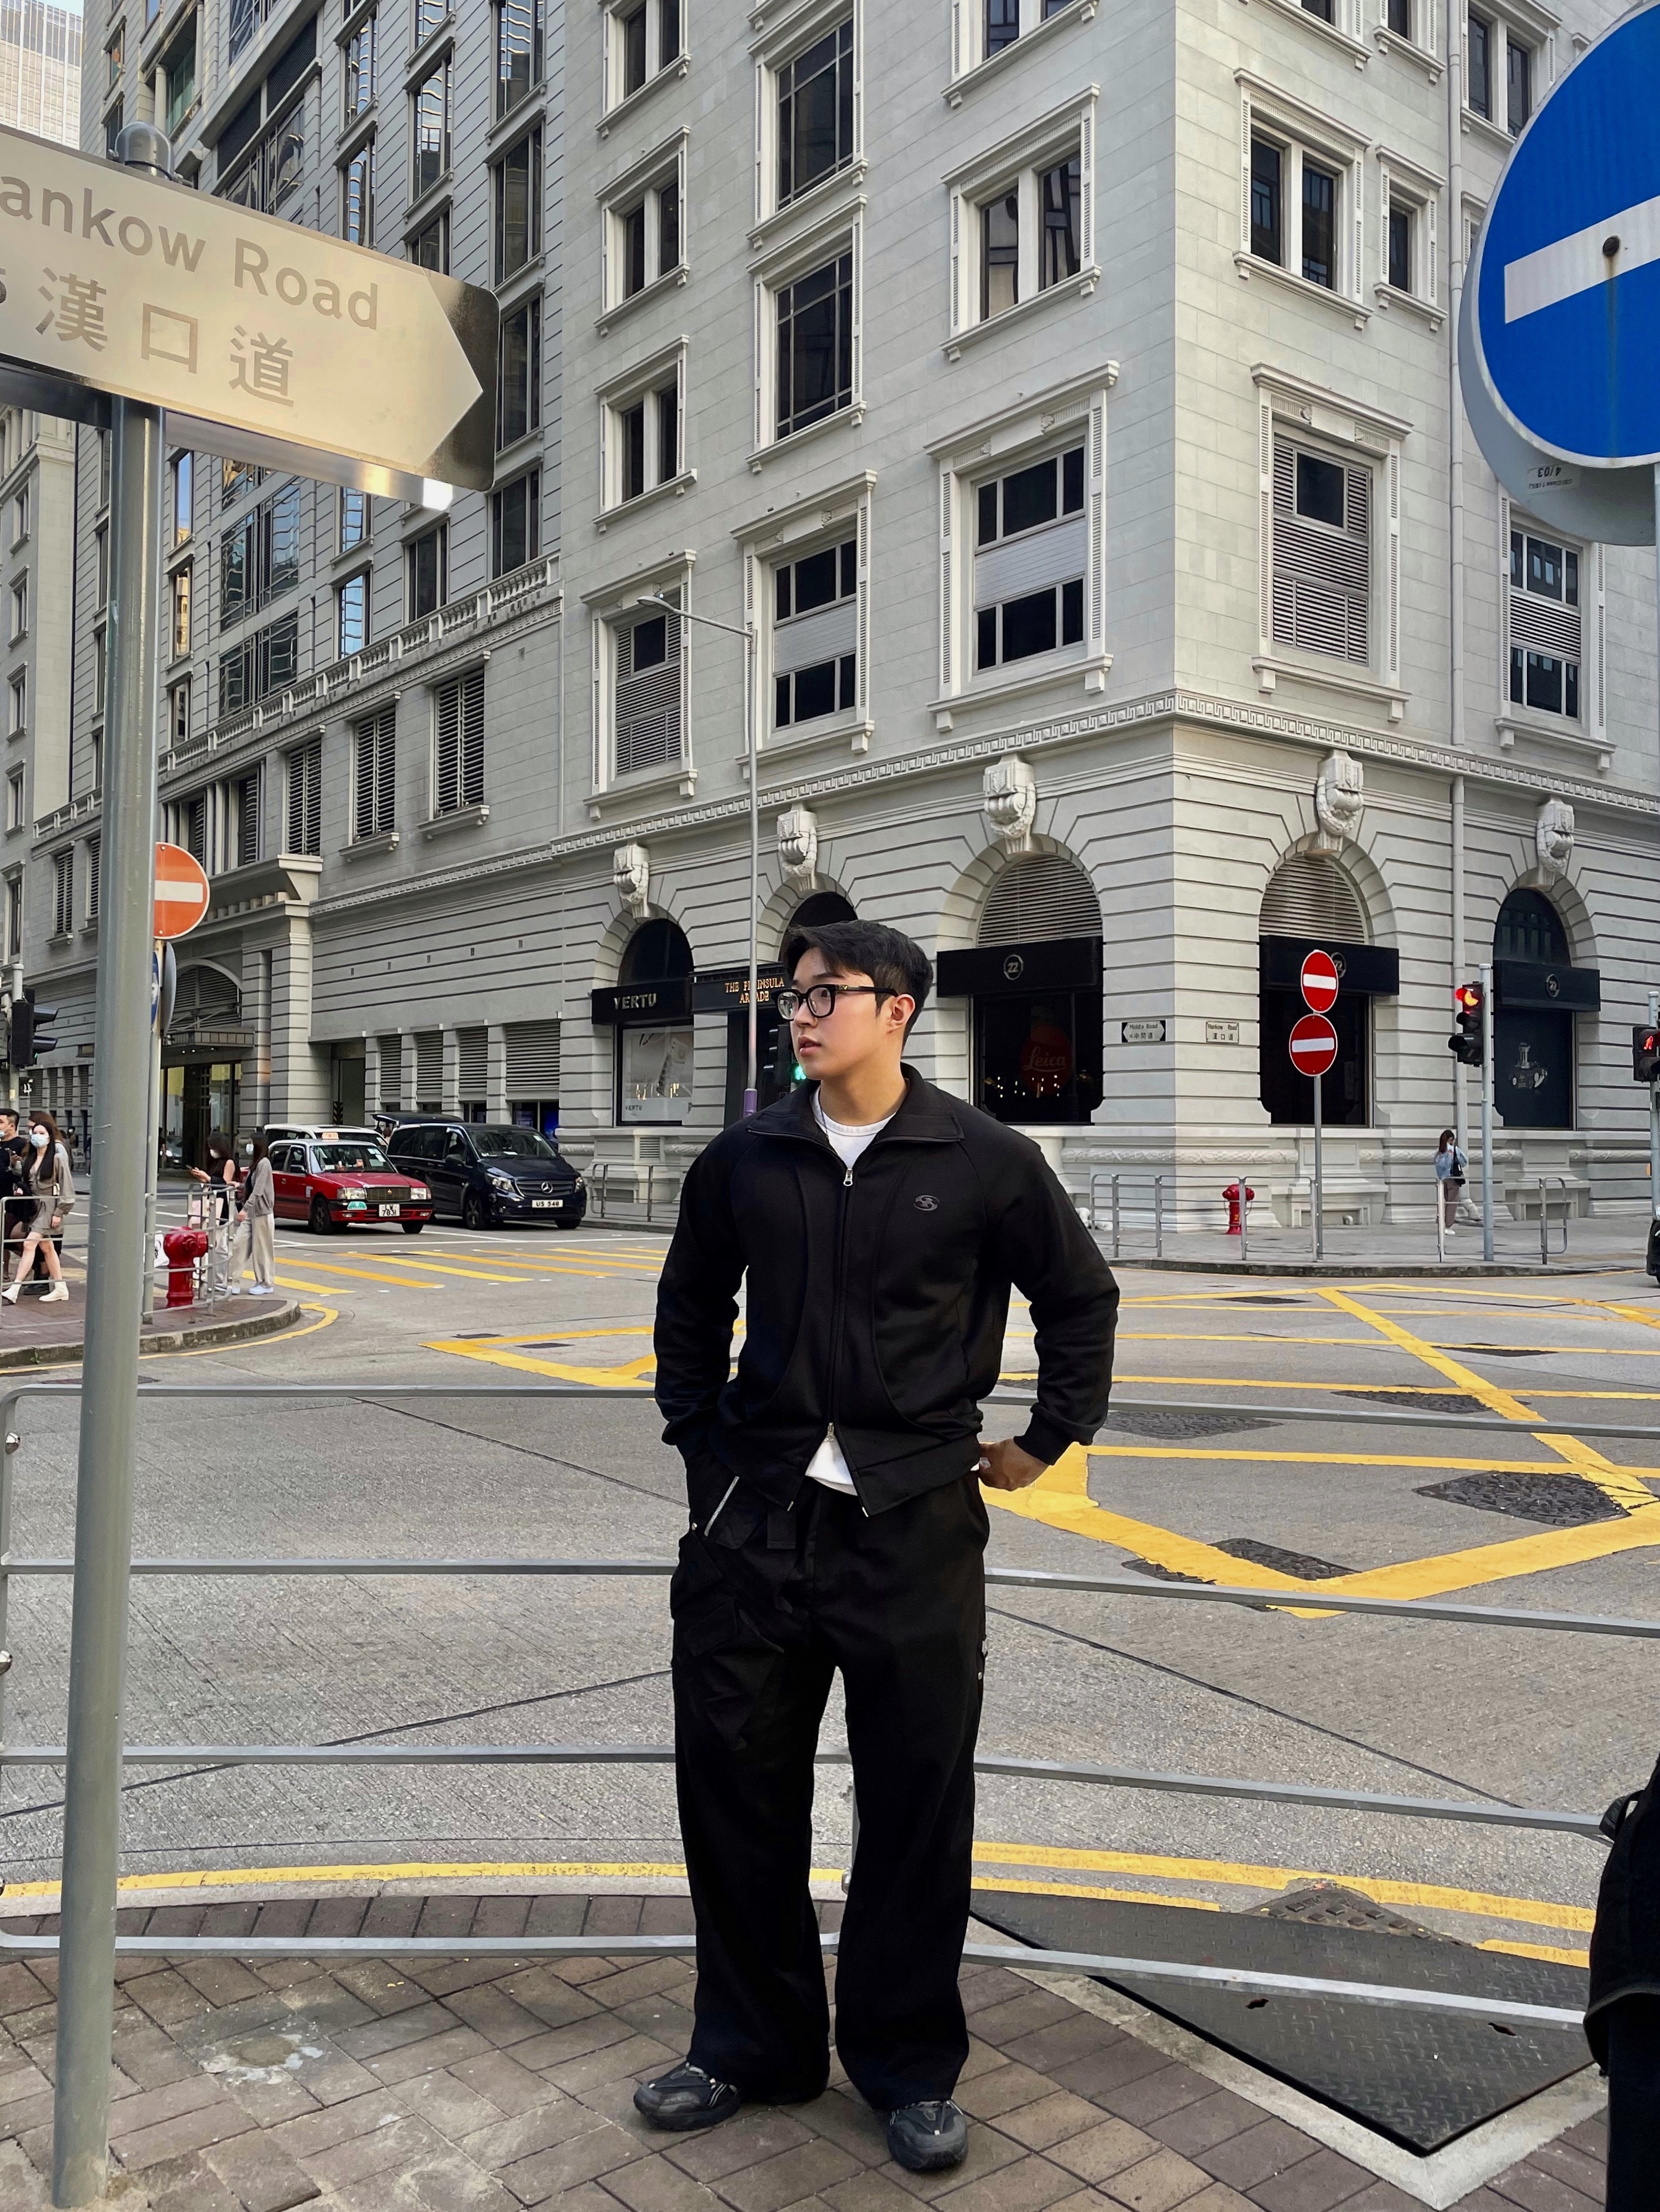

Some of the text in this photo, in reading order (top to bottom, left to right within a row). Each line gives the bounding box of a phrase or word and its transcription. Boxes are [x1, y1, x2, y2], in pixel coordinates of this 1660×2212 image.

[234, 237, 378, 330] Road
[35, 266, 295, 408] 漢口道
[1537, 465, 1562, 478] 4/03
[725, 978, 785, 993] THE PINSULA
[613, 993, 657, 1010] VERTU
[739, 991, 769, 1004] ARADE
[1023, 1046, 1067, 1072] Leica
